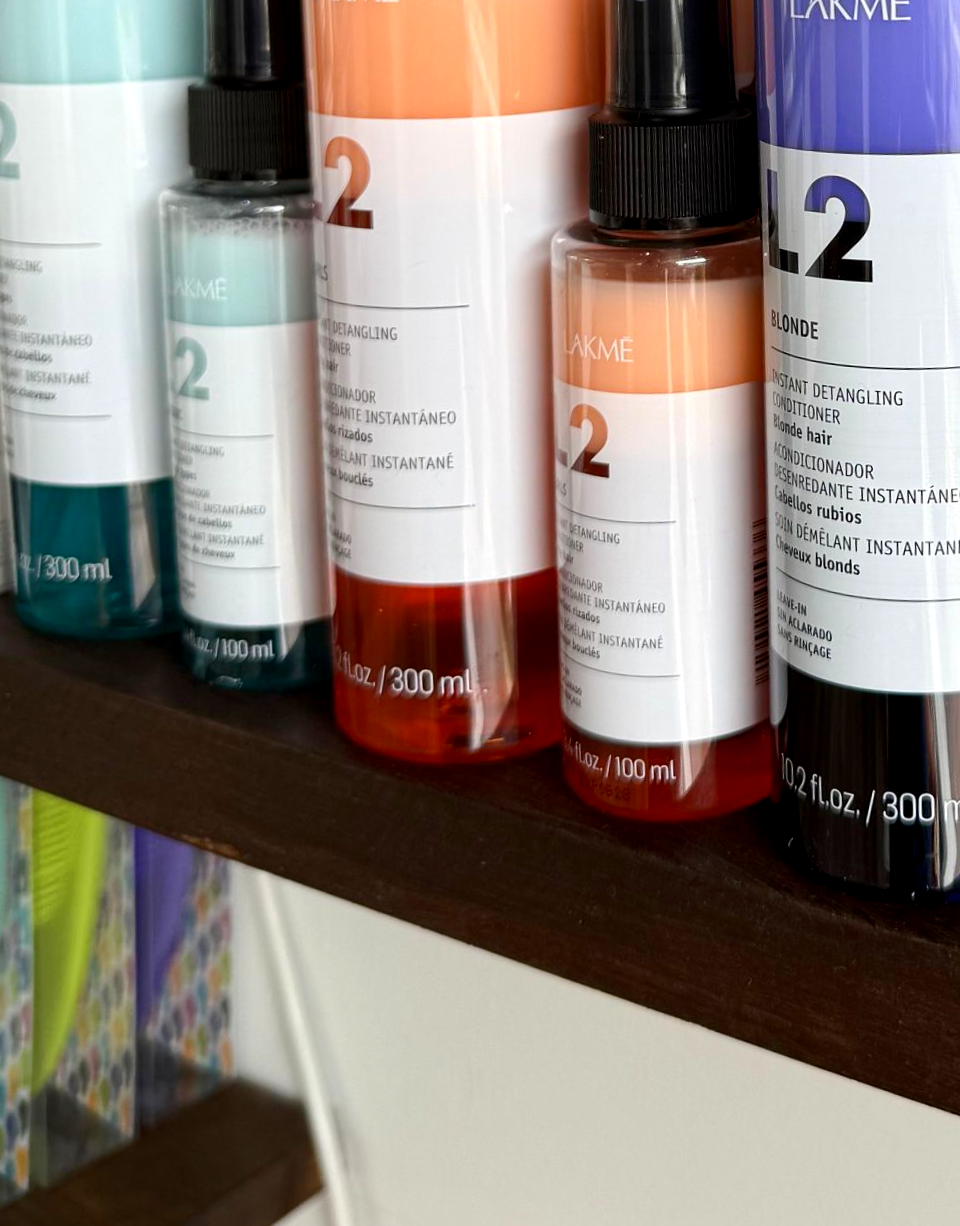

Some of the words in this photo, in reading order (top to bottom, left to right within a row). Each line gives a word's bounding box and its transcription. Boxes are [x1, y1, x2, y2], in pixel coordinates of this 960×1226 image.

[324, 135, 374, 230] 2
[767, 168, 873, 283] L2
[333, 320, 398, 341] DETANGLING
[771, 309, 819, 340] BLONDE
[173, 336, 210, 401] 2
[772, 369, 808, 395] INSTANT
[813, 383, 904, 406] DETANGLING
[365, 409, 457, 426] INSTANTÁNEO
[772, 391, 841, 425] CONDITIONER
[338, 425, 373, 444] rizados
[570, 403, 610, 479] 2
[773, 413, 803, 439] Blonde
[806, 427, 833, 446] hair
[372, 452, 454, 471] INSTANTANÉ
[774, 441, 875, 480] ACONDICIONADOR
[338, 467, 374, 487] bouclés
[774, 462, 853, 501] DESENREDANTE
[775, 484, 812, 515] Cabellos
[817, 505, 862, 525] rubios
[569, 521, 620, 545] DETANGLING
[775, 511, 794, 535] SOIN
[796, 522, 860, 553] DÉMÊLANT
[44, 554, 80, 580] 300
[83, 557, 112, 580] ml
[776, 533, 812, 565] Cheveux
[815, 553, 860, 576] blonds
[572, 605, 601, 624] rizados
[594, 597, 666, 614] INSTANTÁNEO
[777, 589, 807, 616] LEAVE-IN
[599, 633, 664, 650] INSTANTANÉ
[788, 615, 833, 642] ACLARADO
[222, 638, 248, 659] 100
[252, 641, 275, 659] ml
[572, 640, 601, 659] bouclés
[794, 635, 832, 660] RINÇAGE
[391, 666, 434, 696] 300
[440, 668, 474, 696] ml
[615, 756, 646, 780] 100
[650, 759, 677, 780] ml
[781, 752, 806, 796] 10.2
[810, 773, 860, 819] fl.oz.
[882, 791, 935, 823] 300
